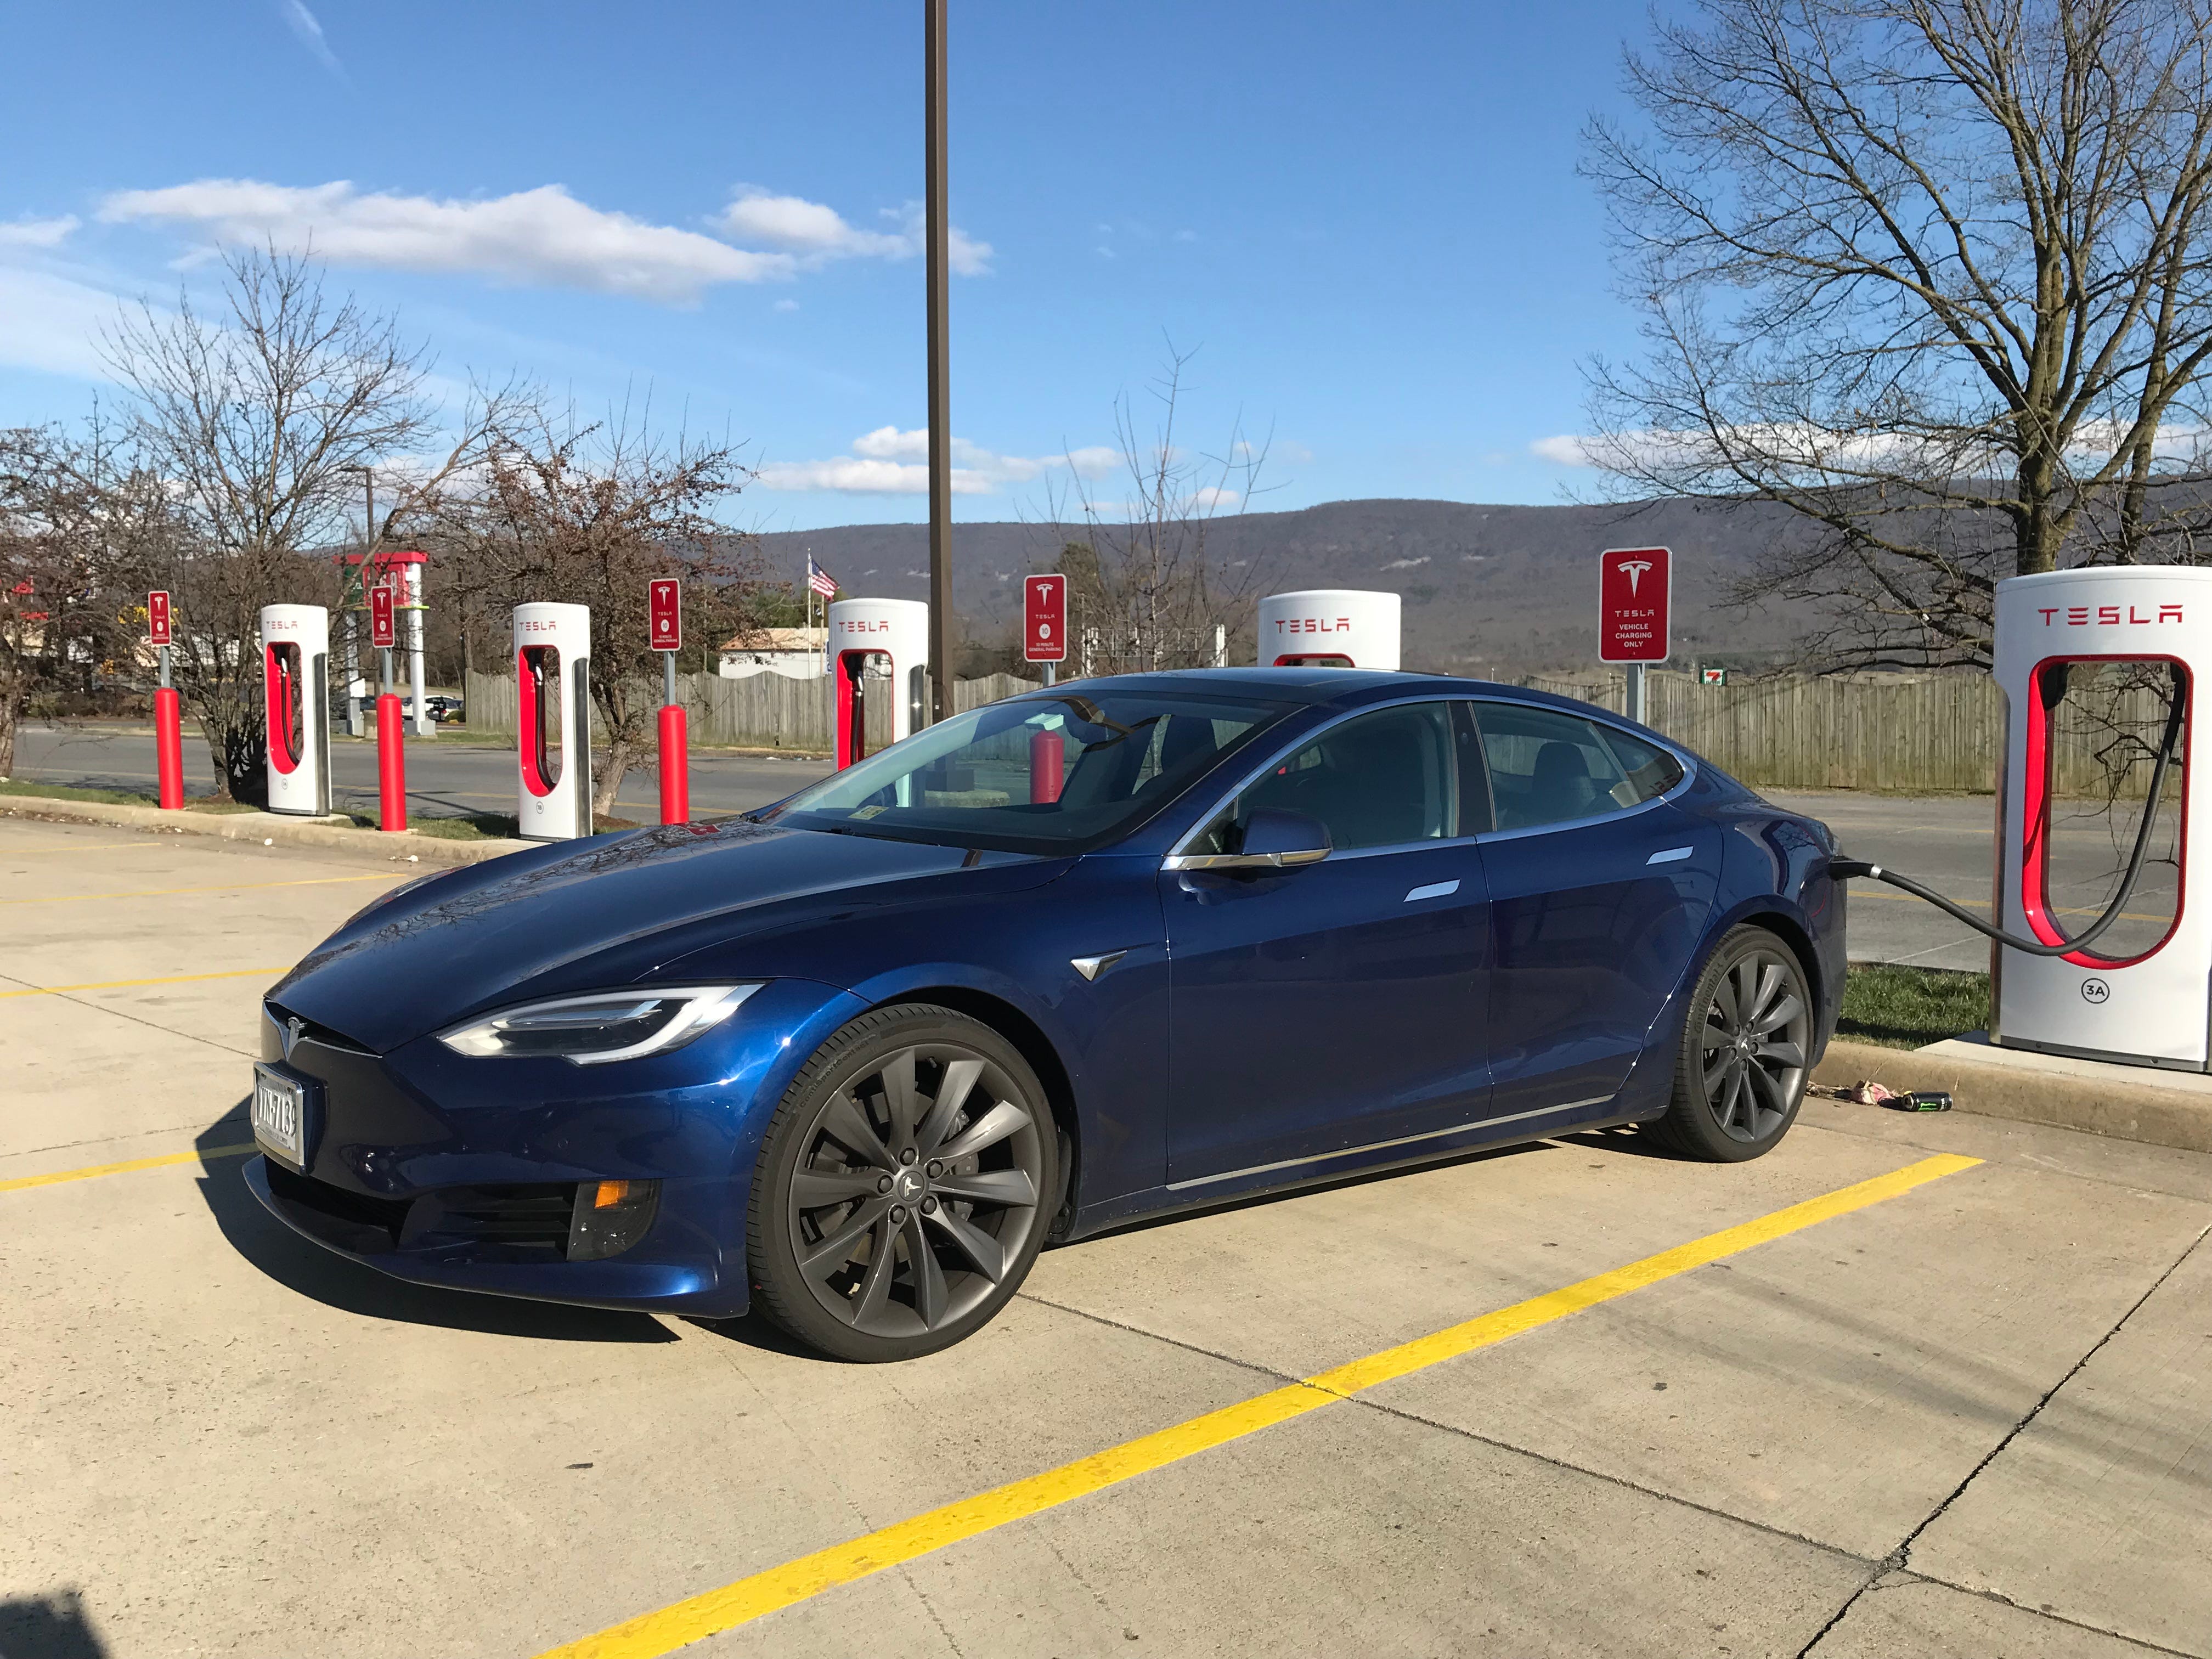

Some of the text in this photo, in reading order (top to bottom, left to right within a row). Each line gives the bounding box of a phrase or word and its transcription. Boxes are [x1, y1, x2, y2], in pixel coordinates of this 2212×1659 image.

[1615, 609, 1655, 618] TESLA
[2038, 605, 2183, 627] TESLA
[266, 620, 298, 630] TESLA
[519, 621, 556, 631] TESLA
[838, 621, 889, 632] TESLA
[1275, 618, 1350, 634] TESLA
[2086, 985, 2106, 996] 3A
